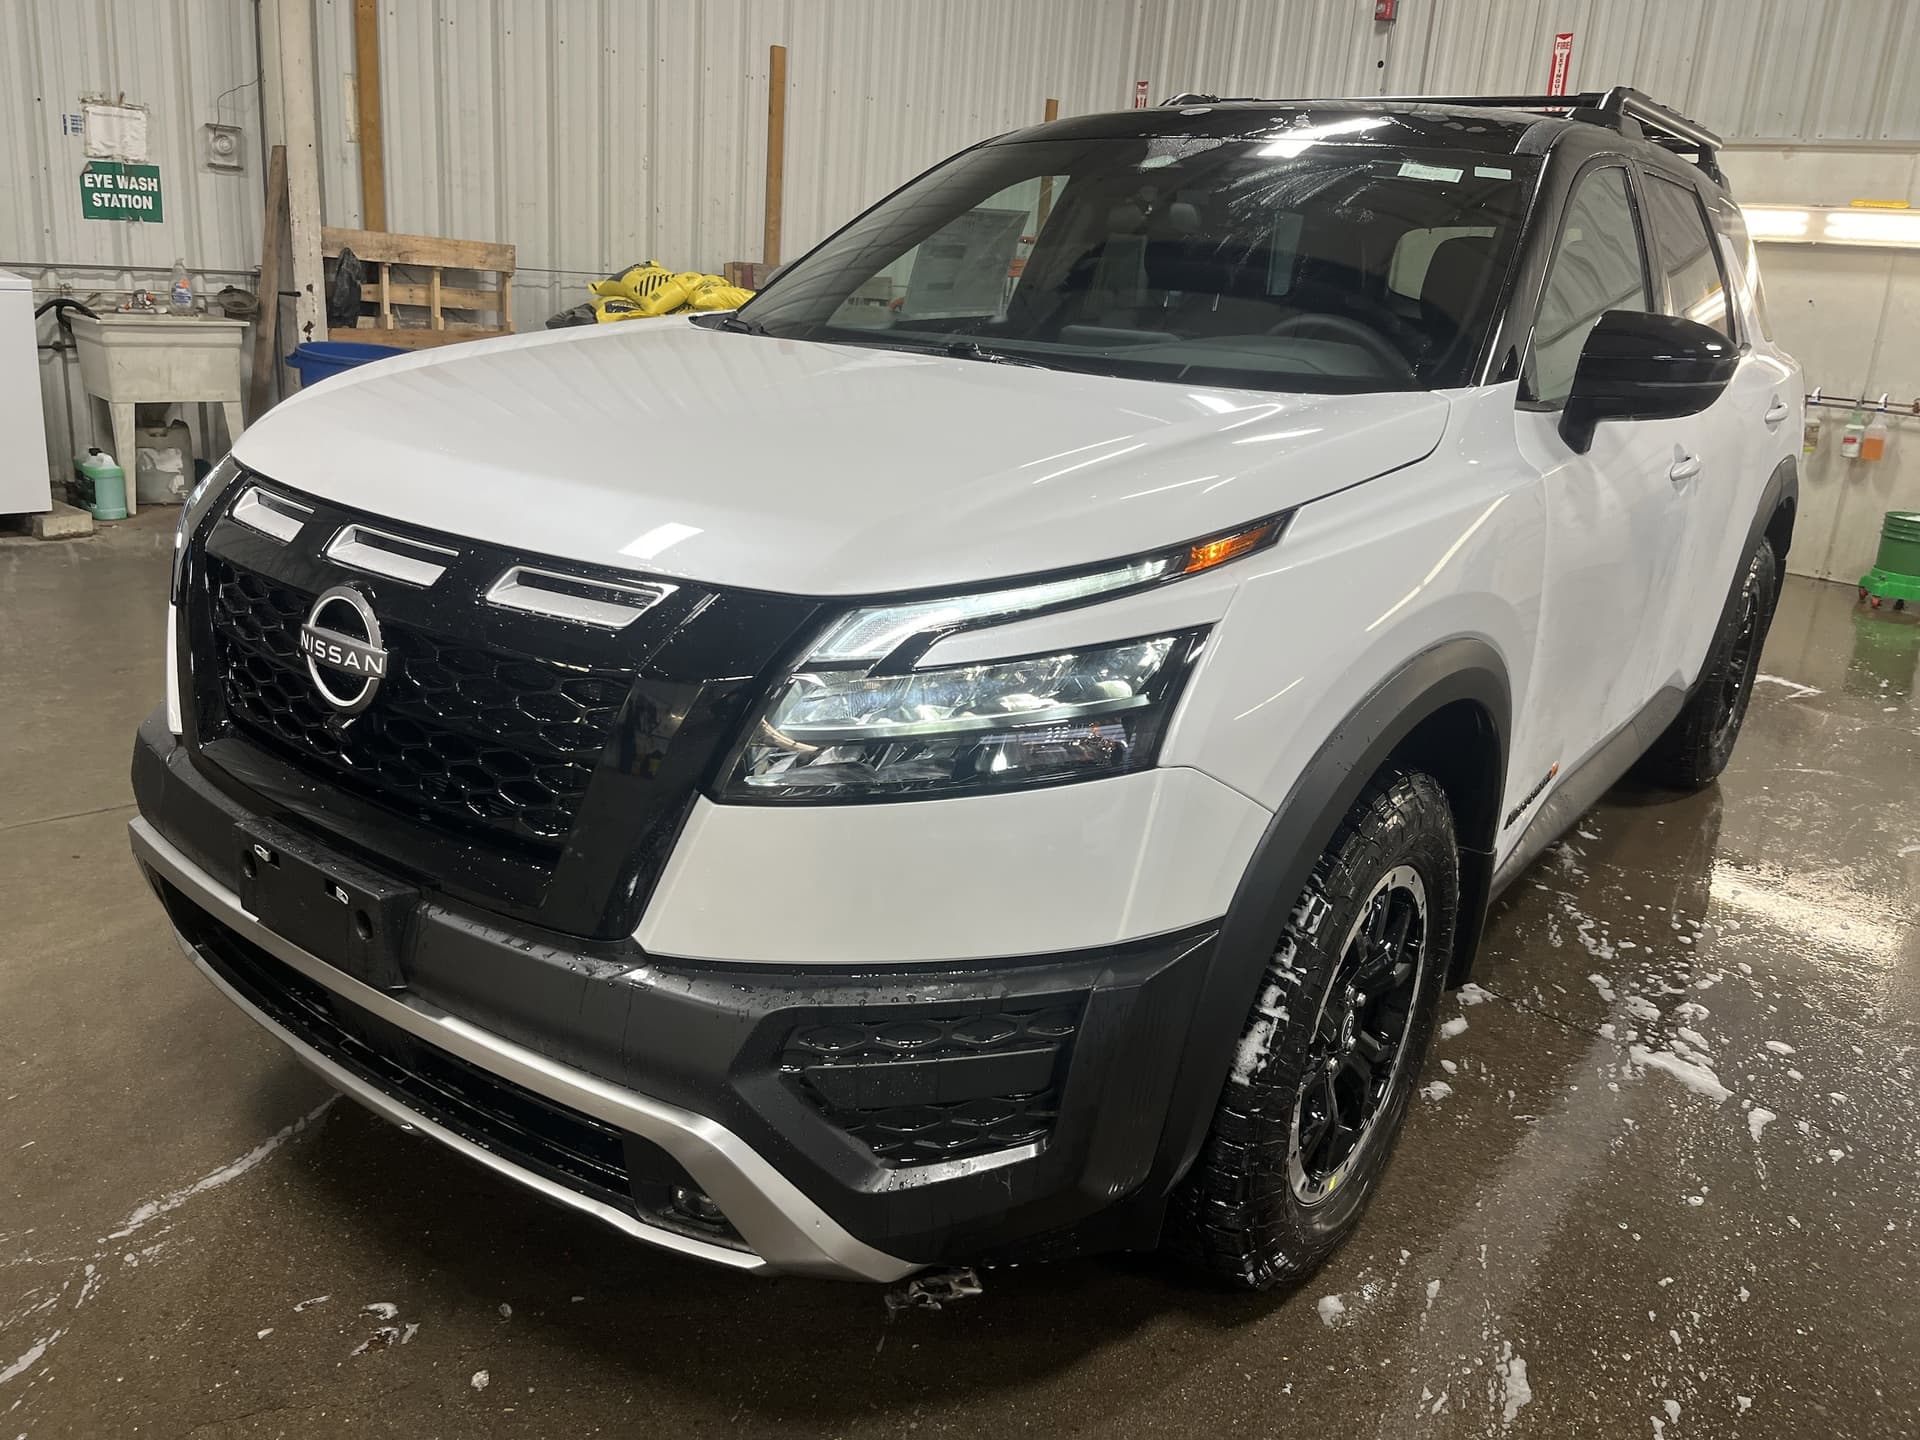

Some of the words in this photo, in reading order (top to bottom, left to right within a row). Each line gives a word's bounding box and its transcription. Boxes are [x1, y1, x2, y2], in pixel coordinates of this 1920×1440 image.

[1557, 41, 1571, 49] FIRE
[1554, 53, 1564, 96] EXTINGUI
[84, 173, 113, 189] EYE
[116, 175, 158, 191] WASH
[92, 192, 153, 210] STATION
[301, 629, 384, 674] NISSAN
